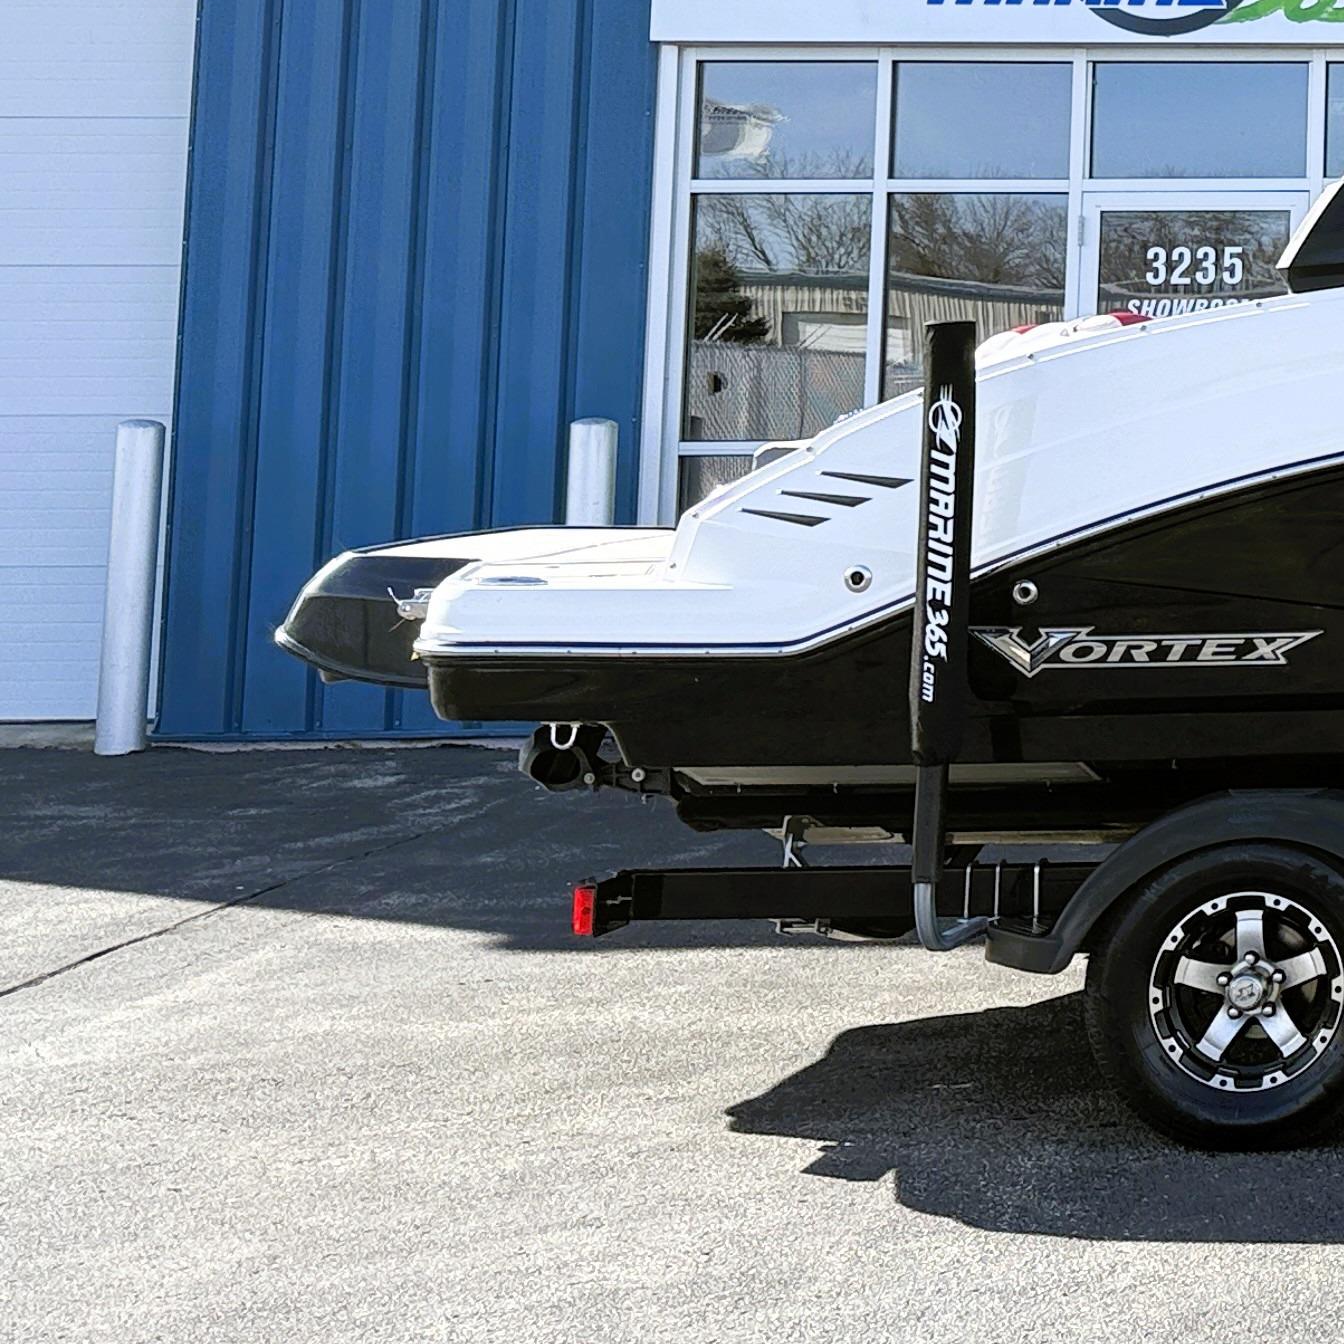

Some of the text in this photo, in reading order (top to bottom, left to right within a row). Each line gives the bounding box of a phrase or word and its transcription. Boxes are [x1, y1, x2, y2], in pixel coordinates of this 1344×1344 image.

[1145, 246, 1243, 285] 3235
[1127, 299, 1249, 318] SHOWR
[968, 626, 1298, 678] VORTEX
